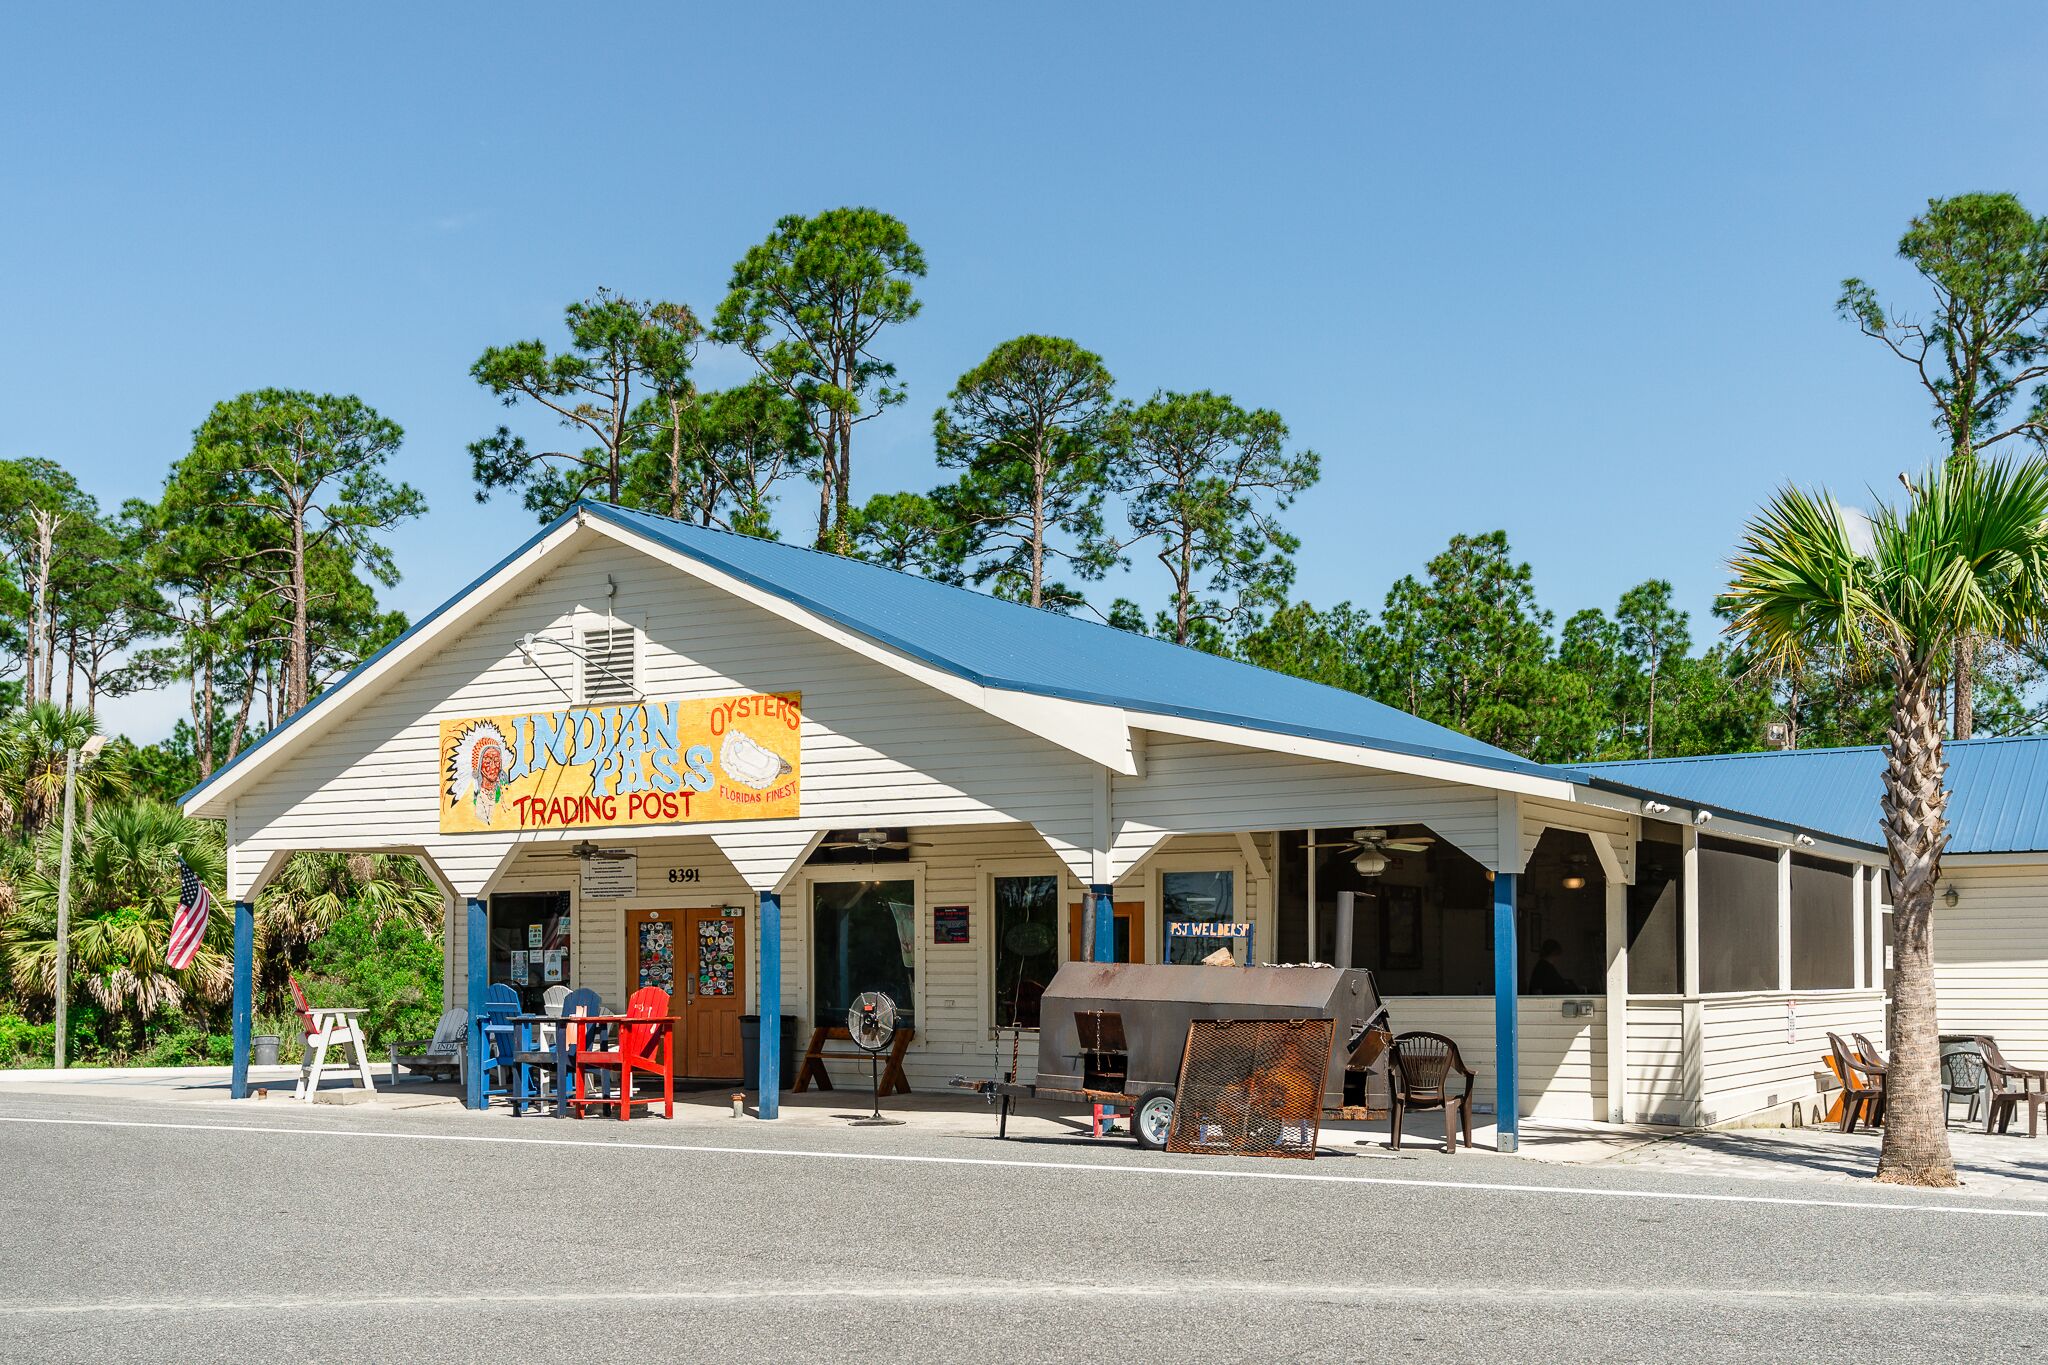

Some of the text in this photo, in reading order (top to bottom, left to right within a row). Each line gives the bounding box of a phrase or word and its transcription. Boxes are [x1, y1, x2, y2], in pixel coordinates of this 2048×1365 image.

[711, 695, 800, 736] OYSTERS
[509, 701, 680, 783] INDIAN
[590, 745, 715, 798] PASS
[513, 791, 695, 825] TRADING POST
[720, 780, 797, 803] FLORIDAS FINEST
[668, 868, 700, 883] 8391
[1171, 922, 1190, 935] PSJ
